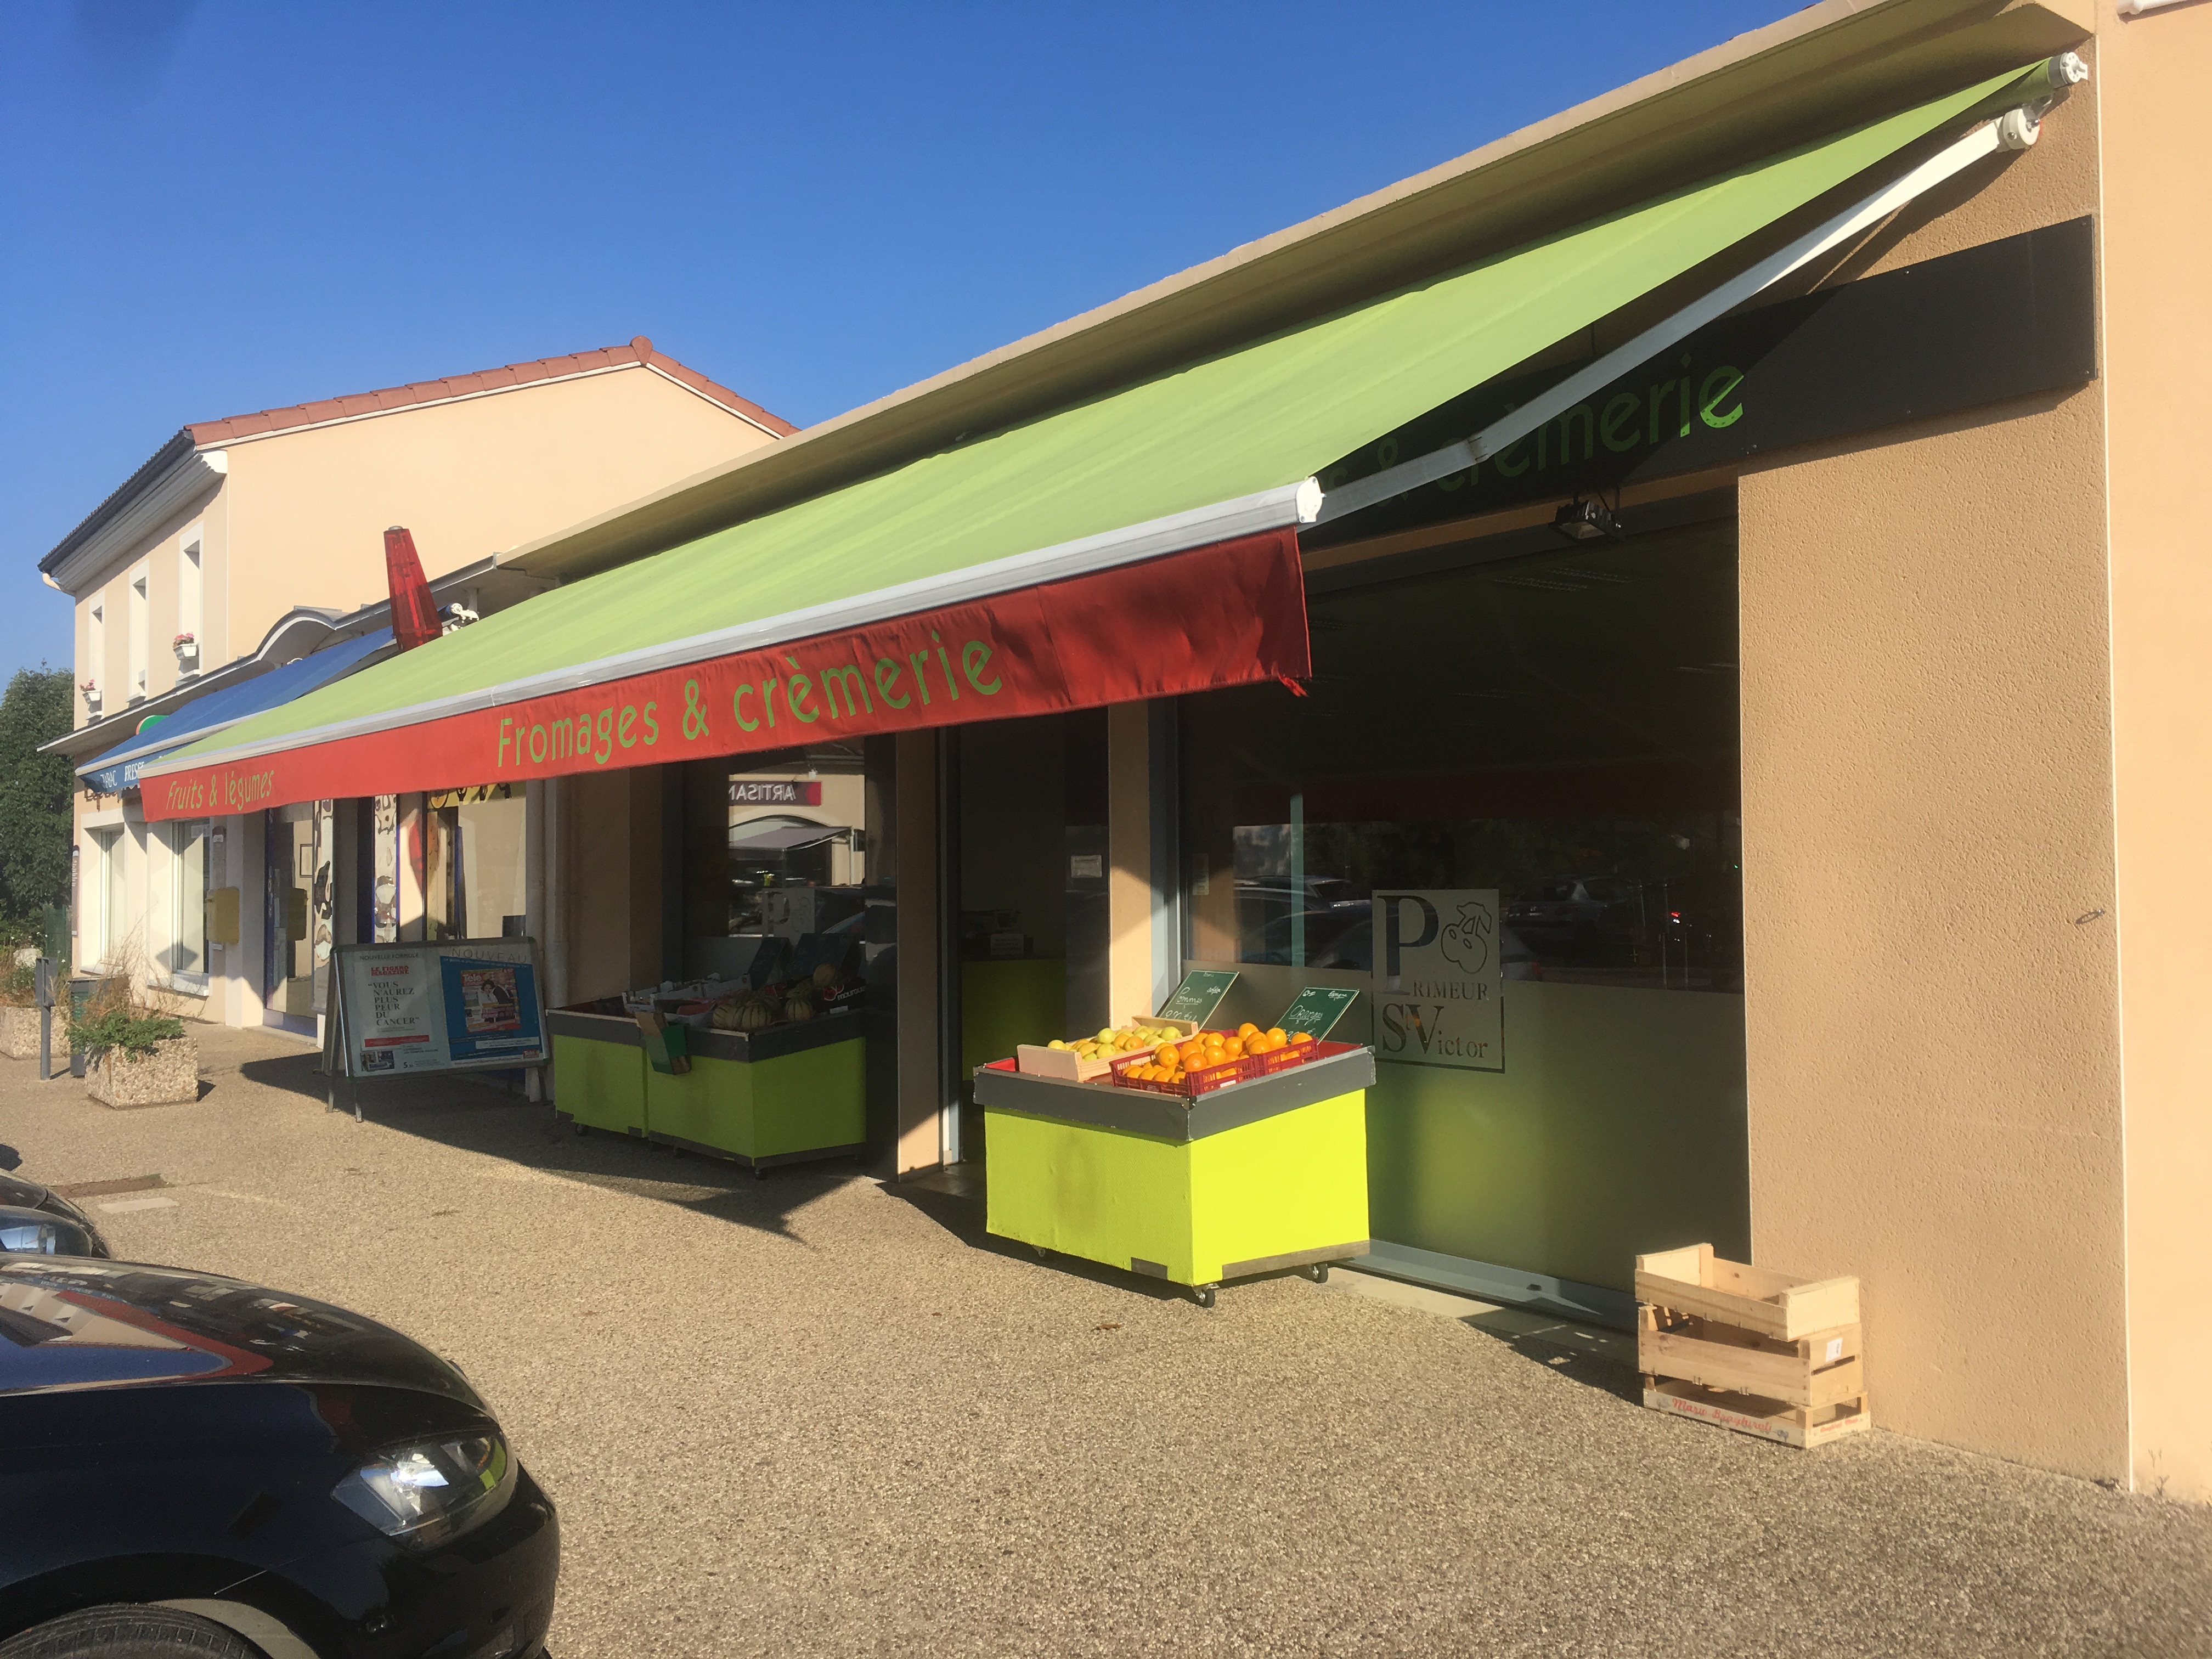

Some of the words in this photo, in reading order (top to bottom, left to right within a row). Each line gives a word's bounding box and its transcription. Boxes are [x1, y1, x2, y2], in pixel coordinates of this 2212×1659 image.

[498, 700, 659, 768] Fromages
[682, 678, 709, 741] &
[733, 629, 1003, 733] crèmerie
[100, 770, 117, 788] TABAC
[166, 780, 204, 810] Fruits
[209, 774, 217, 806] &
[225, 769, 274, 811] légumes
[452, 948, 527, 963] NOUVEAU
